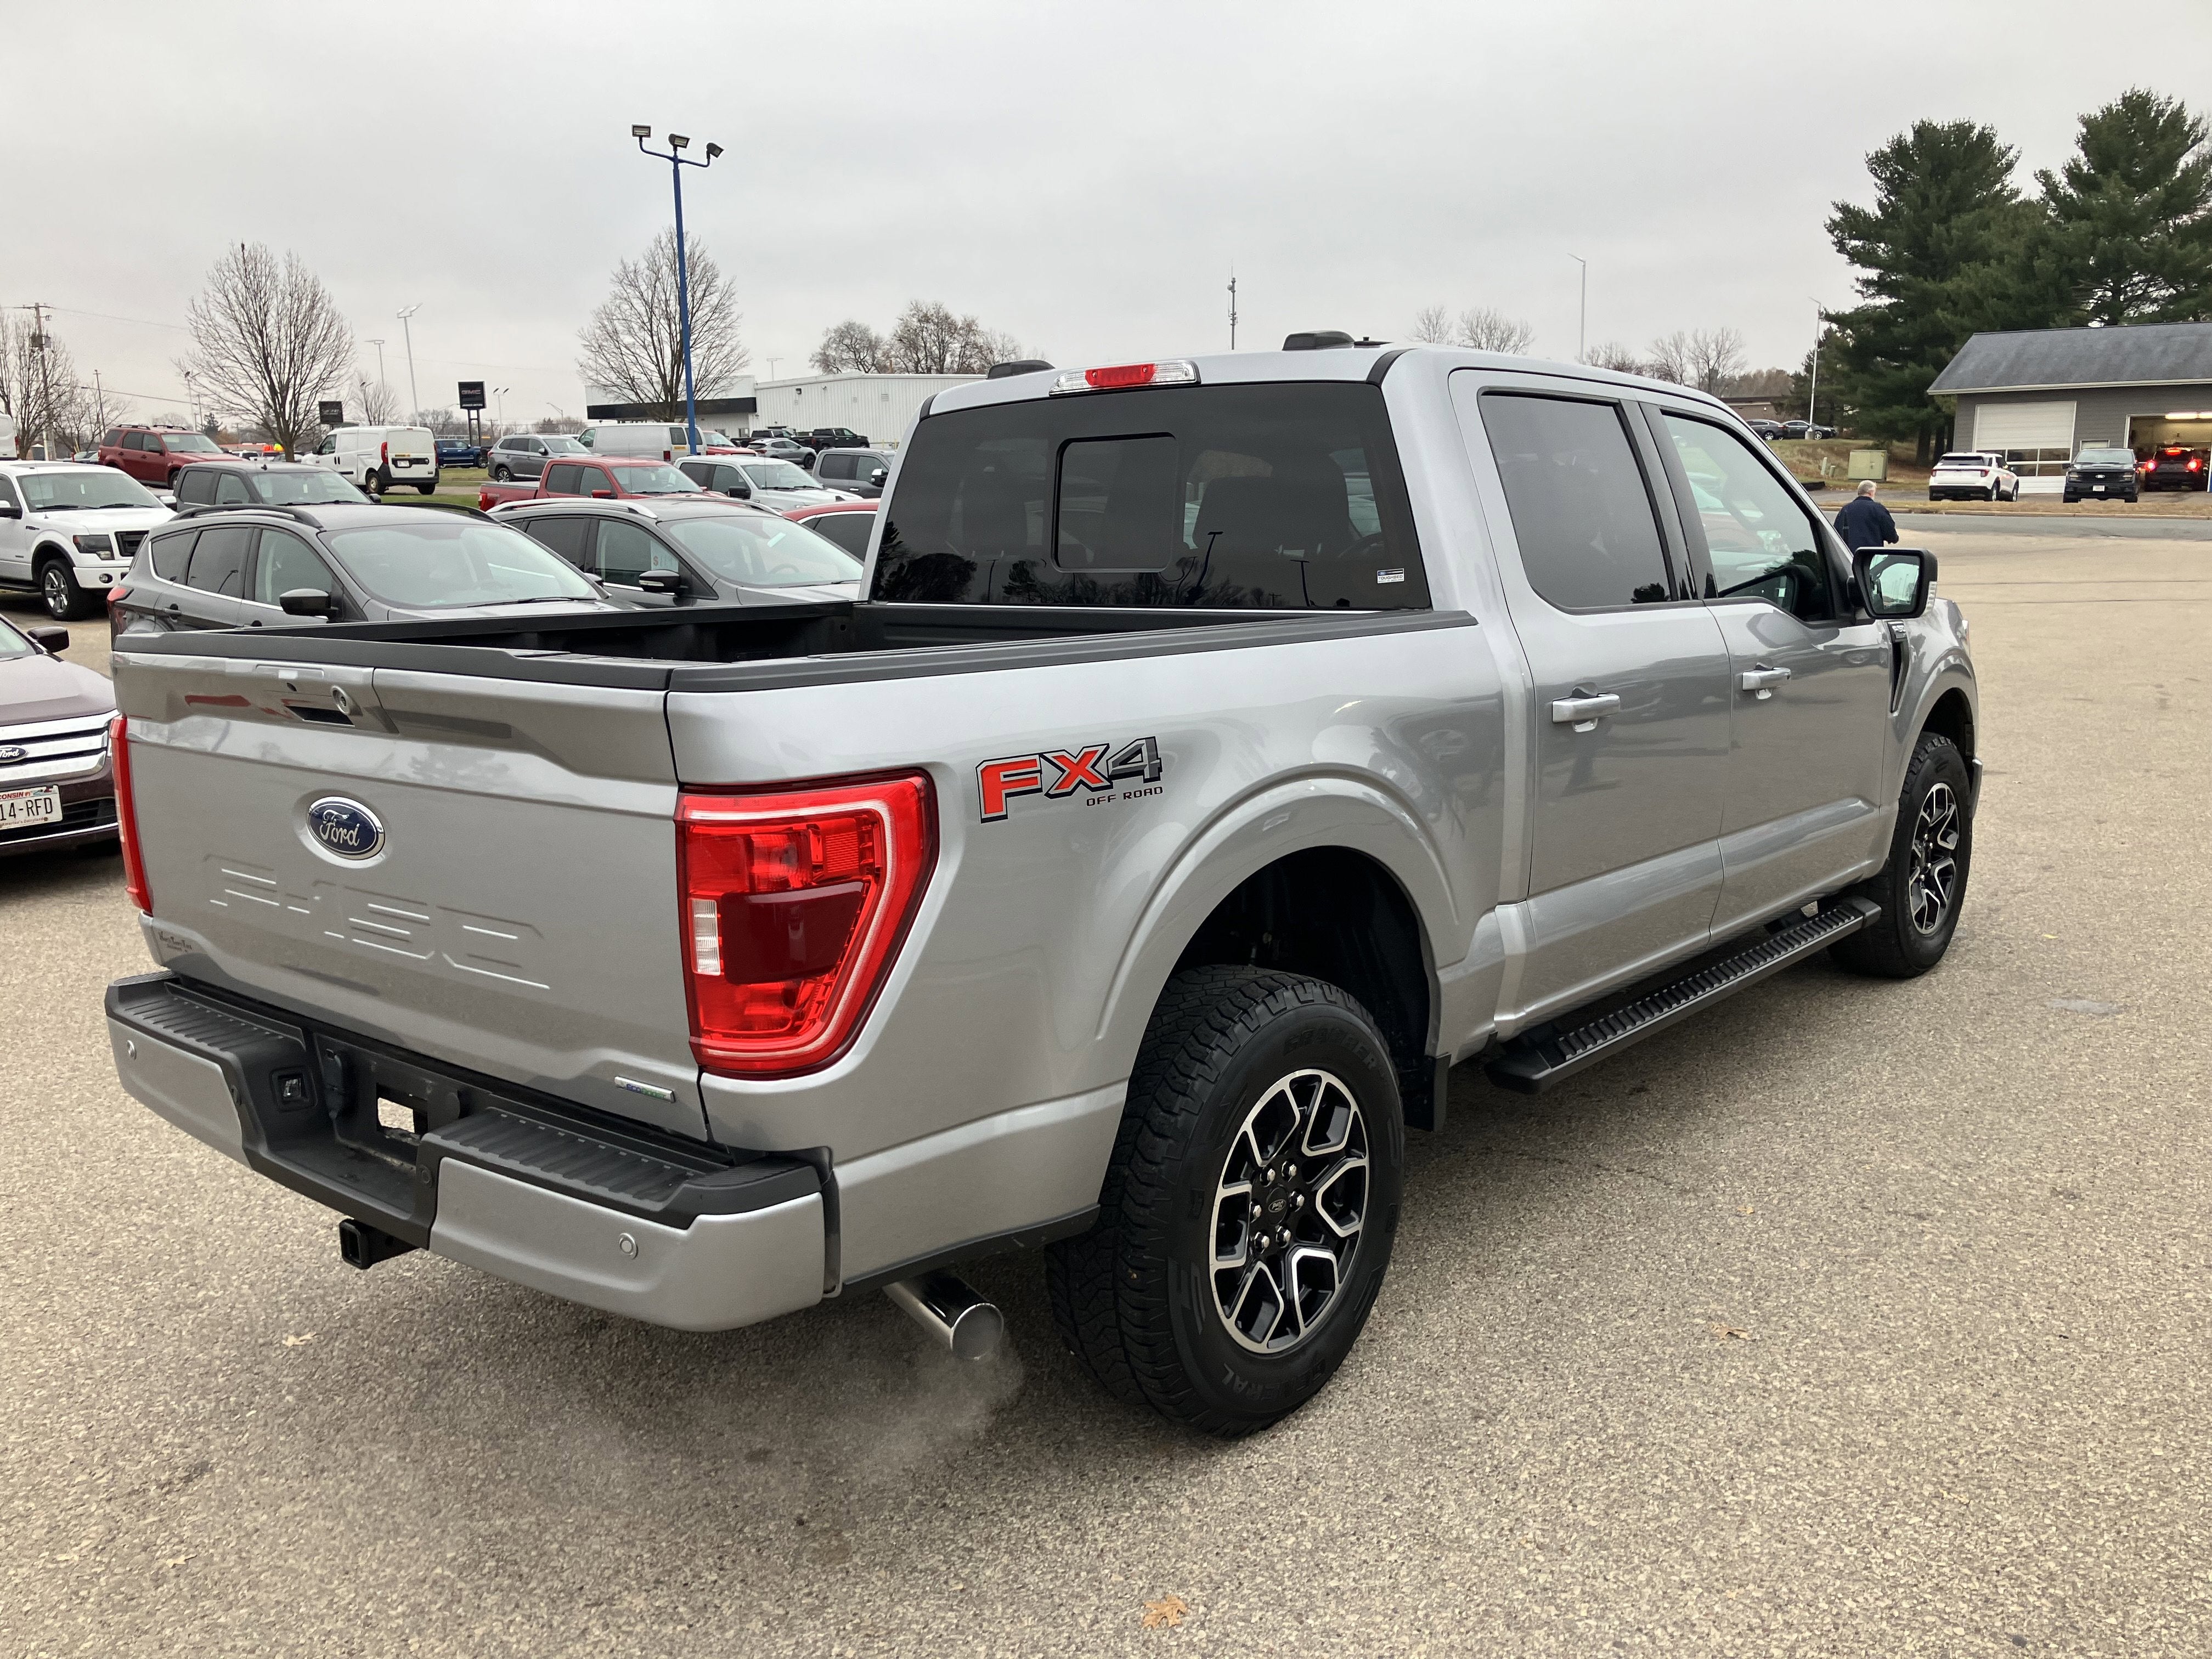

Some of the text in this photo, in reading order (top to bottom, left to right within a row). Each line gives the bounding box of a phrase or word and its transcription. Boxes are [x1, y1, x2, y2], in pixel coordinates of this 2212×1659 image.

[975, 736, 1163, 824] FX4
[1086, 786, 1163, 806] OFF ROAD
[319, 809, 360, 847] Ford
[203, 854, 550, 990] F-150
